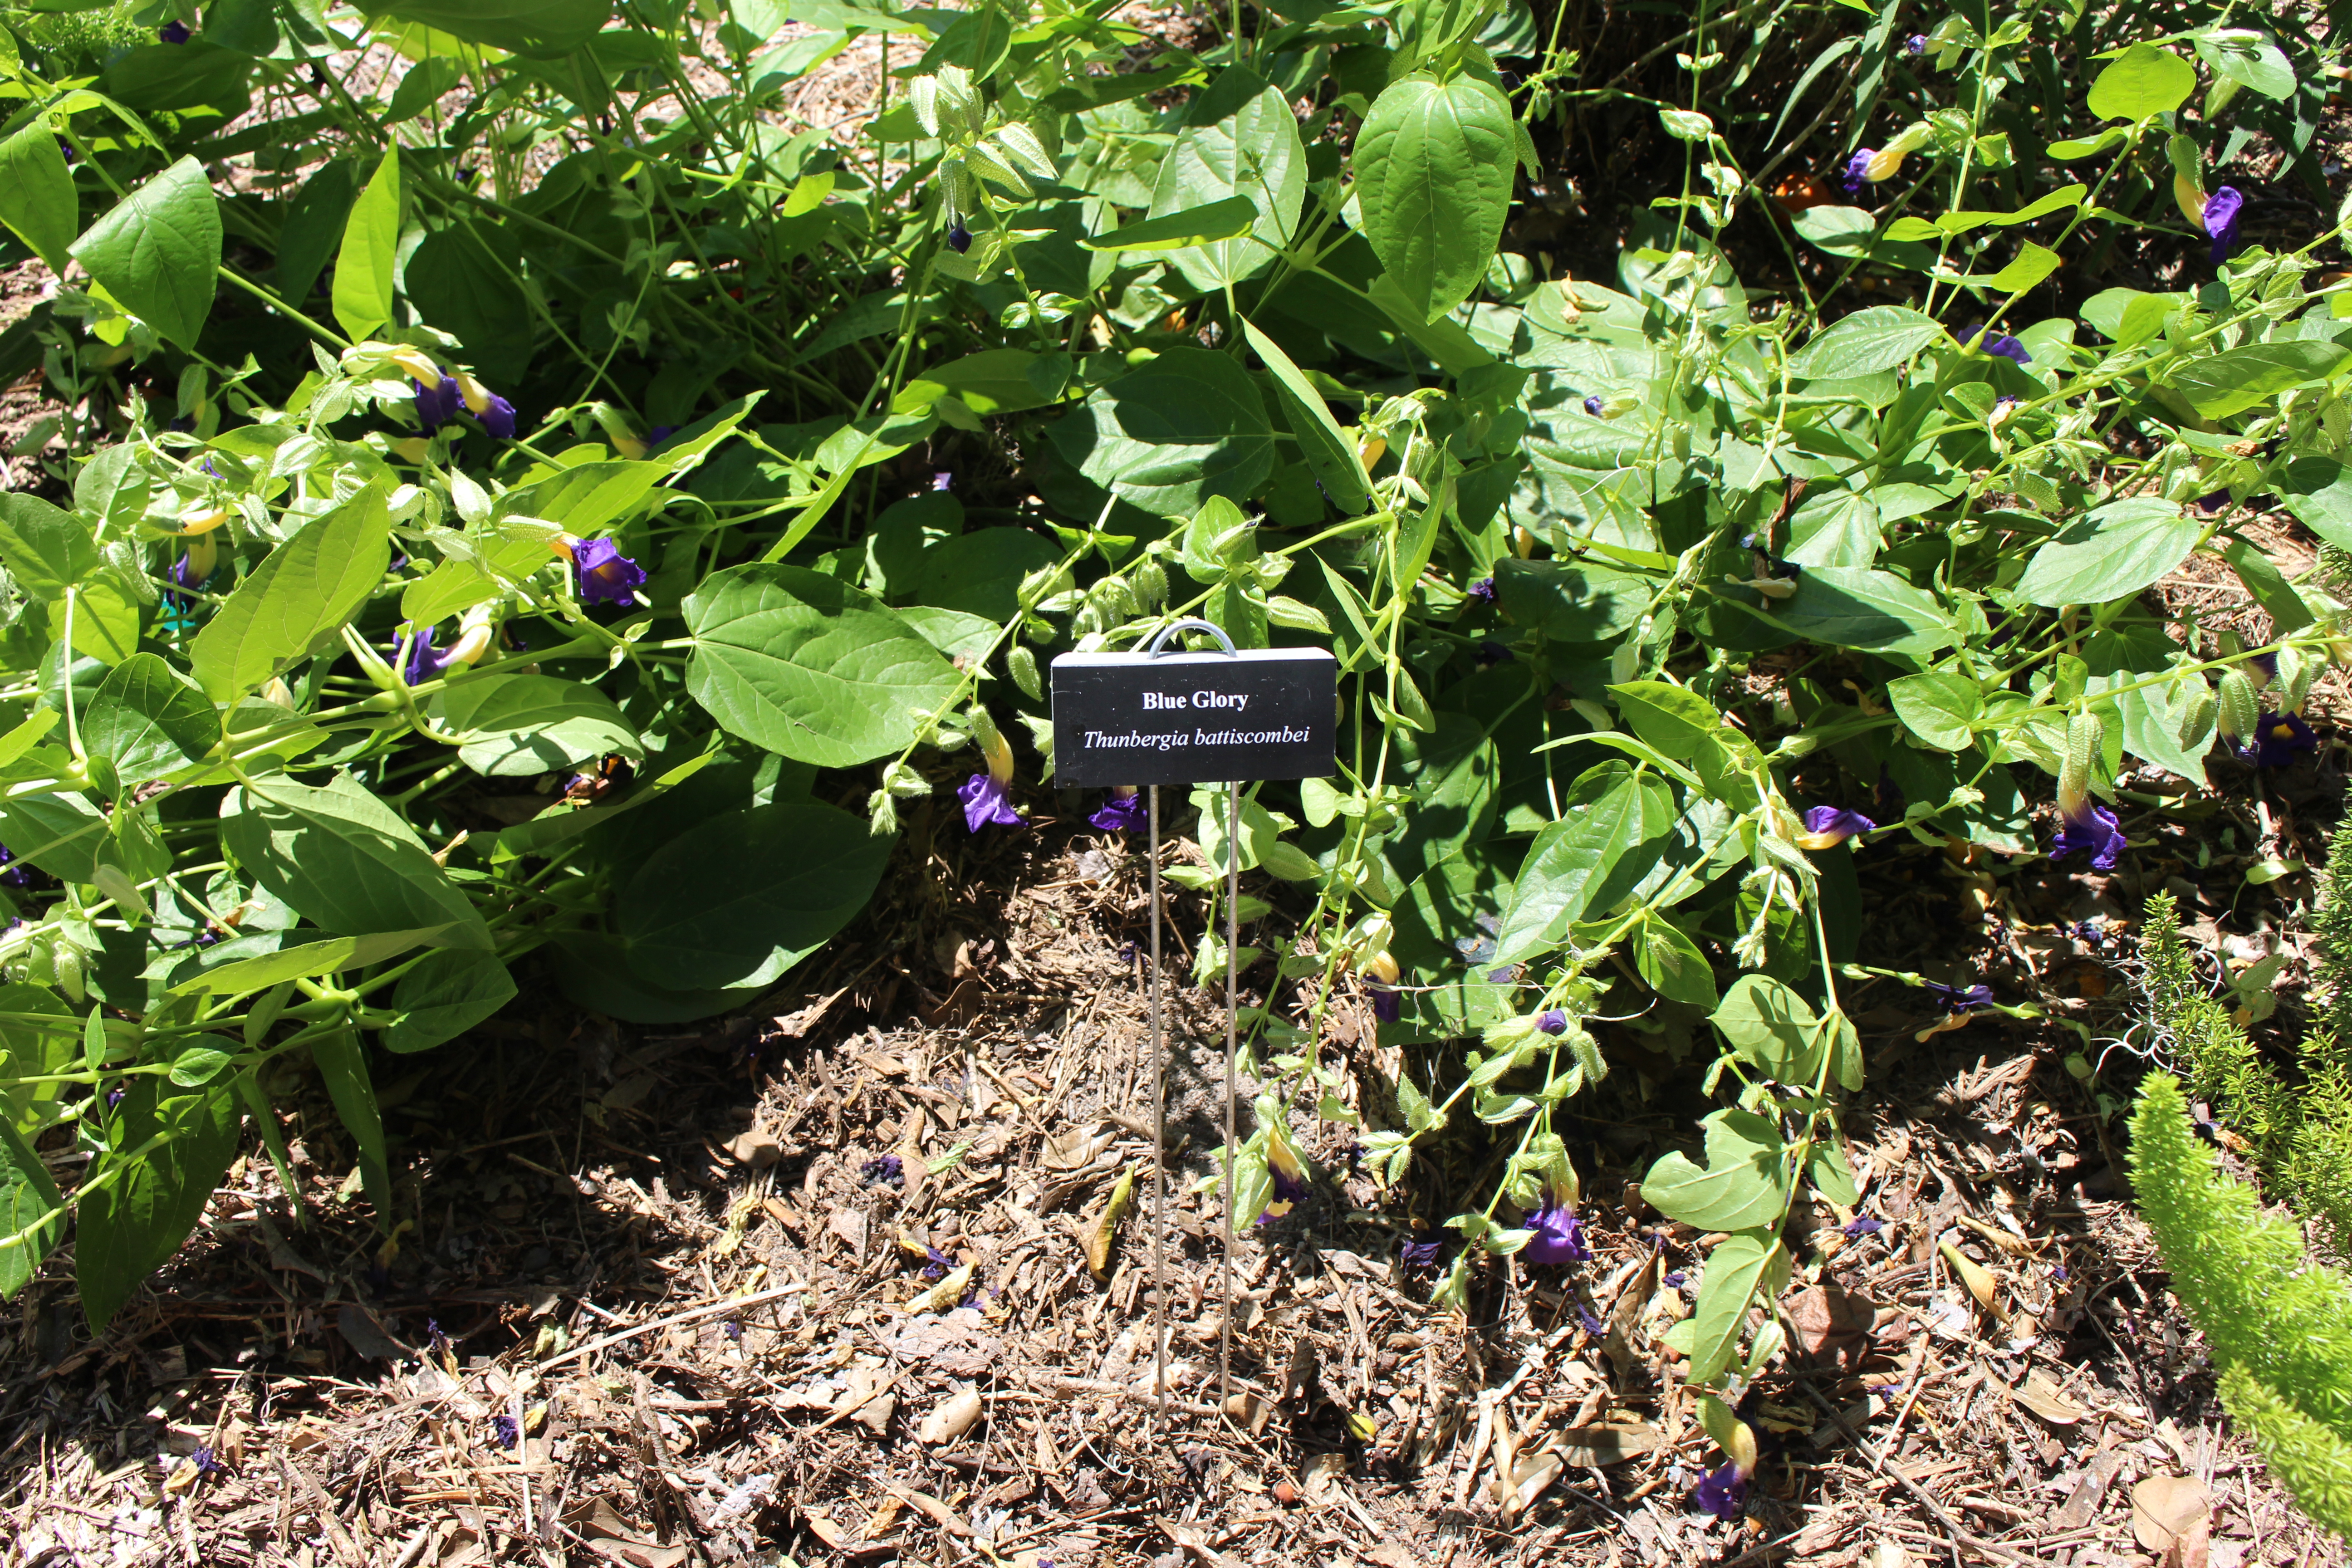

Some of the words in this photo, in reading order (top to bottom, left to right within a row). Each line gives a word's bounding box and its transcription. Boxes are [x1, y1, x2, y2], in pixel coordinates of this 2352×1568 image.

[1142, 692, 1186, 709] Blue
[1192, 691, 1249, 711] Glory
[1085, 730, 1189, 750] Thunbergia
[1195, 726, 1310, 745] battiscombei
